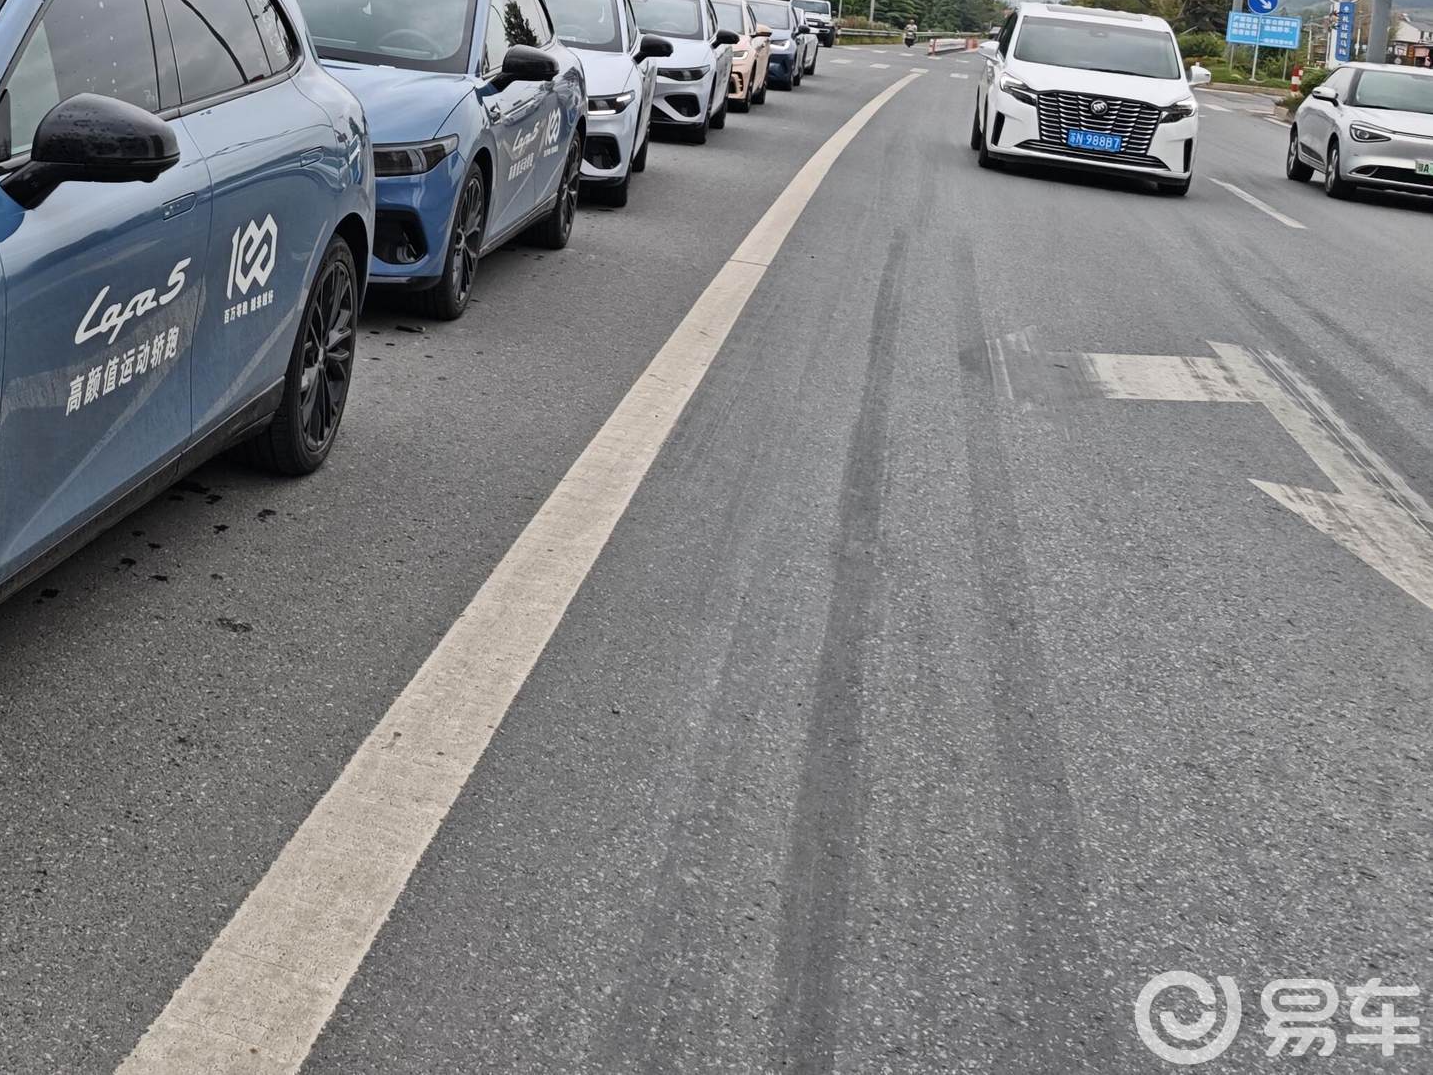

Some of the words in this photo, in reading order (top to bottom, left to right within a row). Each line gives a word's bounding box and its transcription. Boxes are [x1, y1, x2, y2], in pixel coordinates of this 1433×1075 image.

[65, 325, 180, 417] 高颜值运动轿跑
